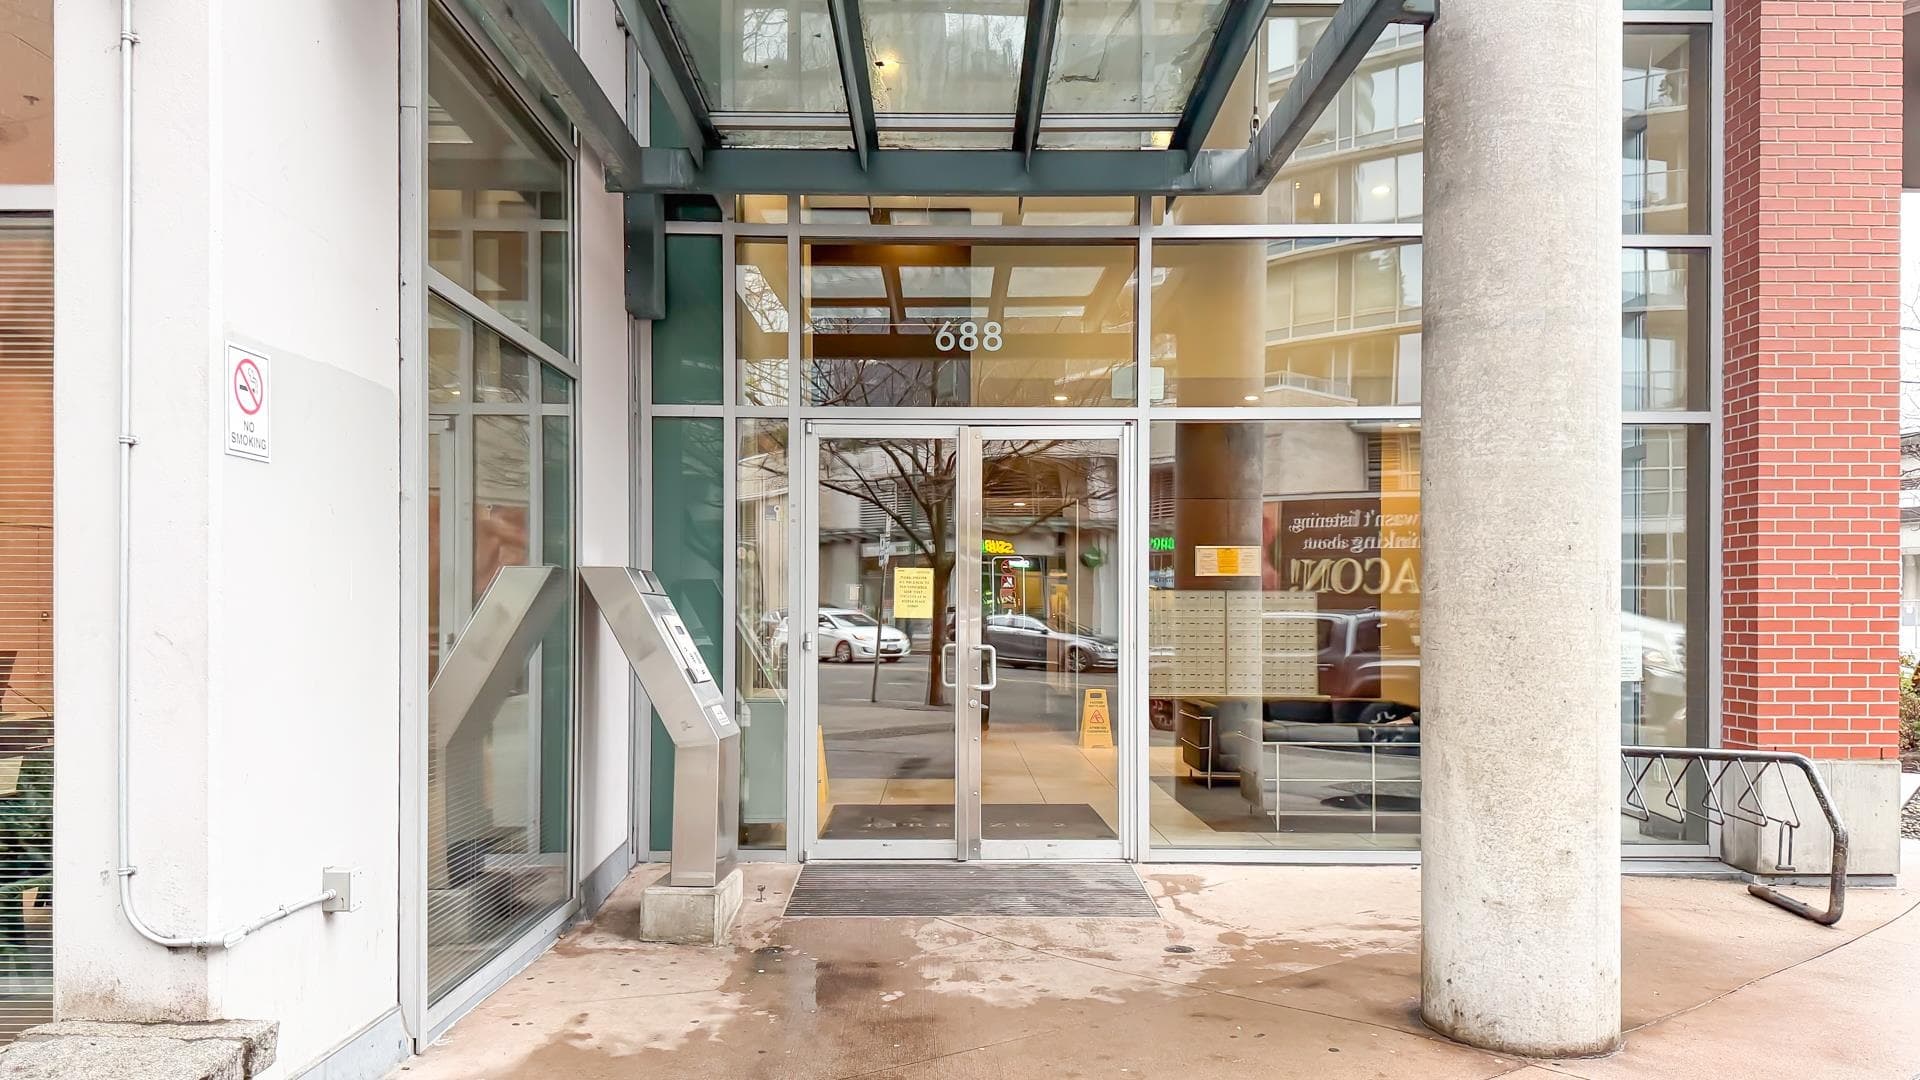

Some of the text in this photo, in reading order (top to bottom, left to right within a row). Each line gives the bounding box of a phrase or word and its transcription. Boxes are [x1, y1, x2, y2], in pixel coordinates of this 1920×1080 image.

[935, 320, 1003, 352] 688
[243, 420, 255, 433] NO
[231, 432, 267, 450] SMOKING
